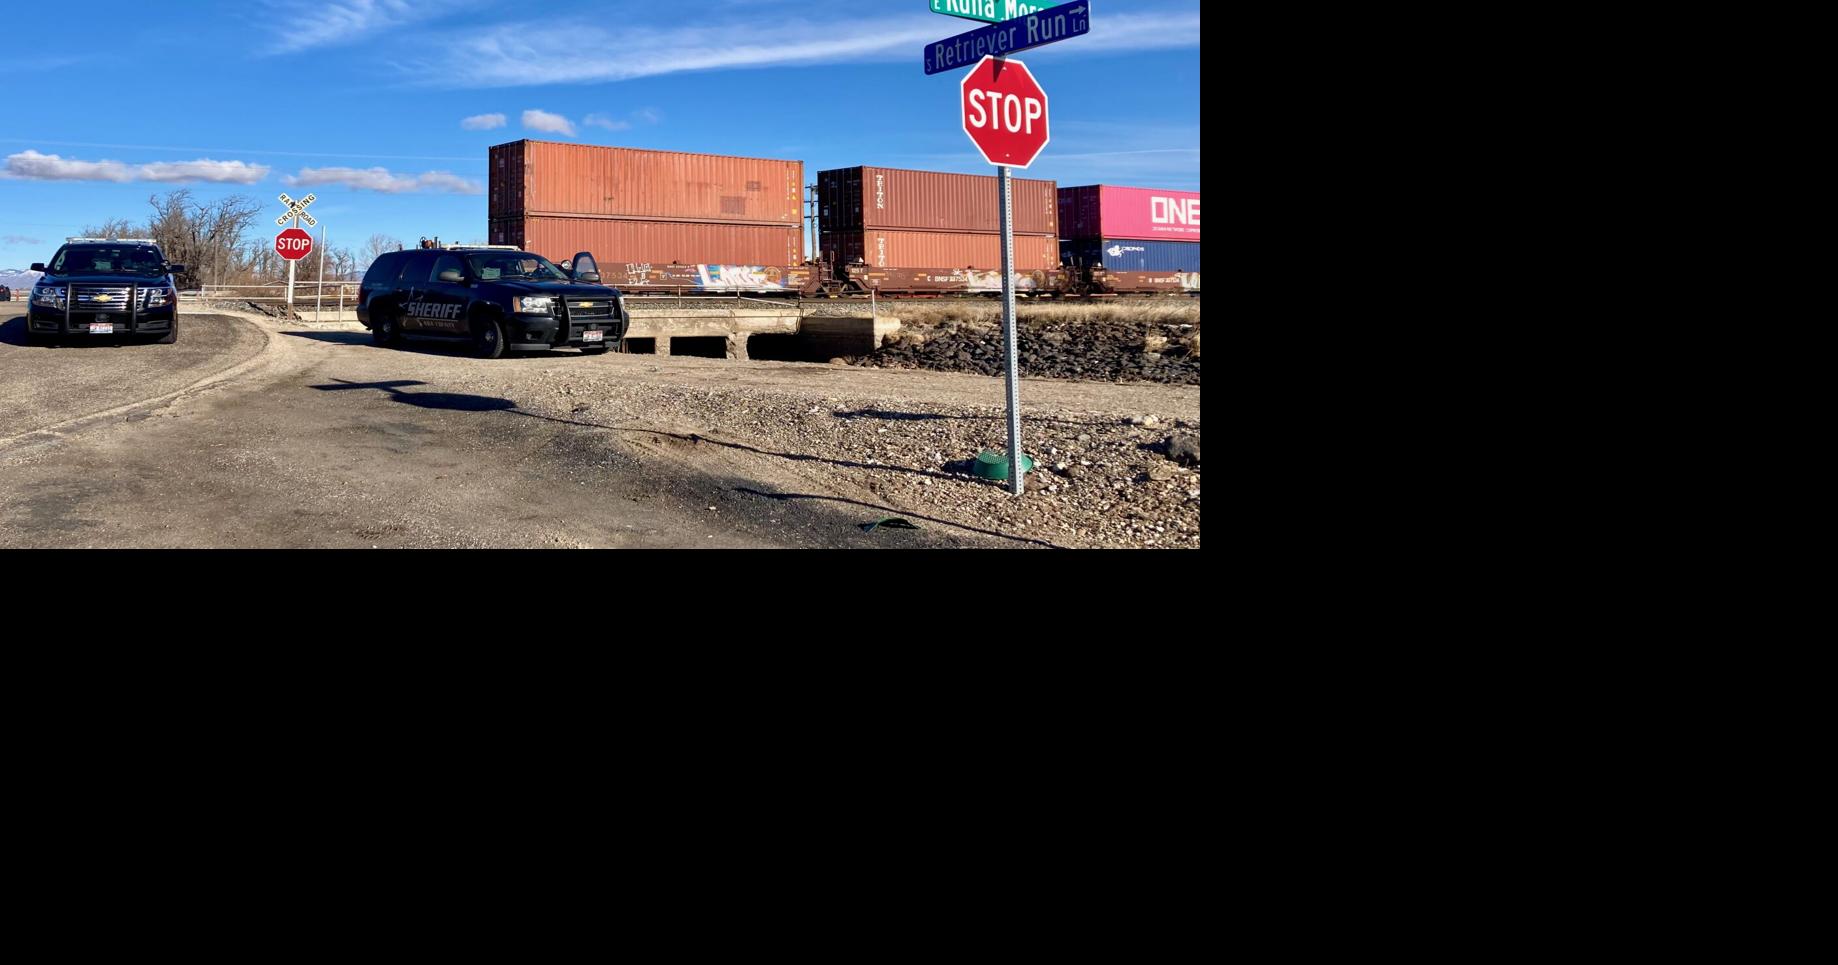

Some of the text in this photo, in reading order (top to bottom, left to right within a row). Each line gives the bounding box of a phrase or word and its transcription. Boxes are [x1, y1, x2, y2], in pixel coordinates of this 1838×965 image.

[934, 0, 941, 10] E
[1005, 0, 1044, 21] Mor
[935, 27, 1017, 70] Retriever
[1027, 13, 1066, 44] Run
[1072, 18, 1086, 33] Ln
[968, 88, 1042, 134] STOP
[876, 174, 884, 209] TRITON
[277, 194, 316, 225] CROSSING
[1151, 196, 1200, 225] ONE
[277, 237, 310, 251] STOP
[407, 302, 462, 319] SHERIFF
